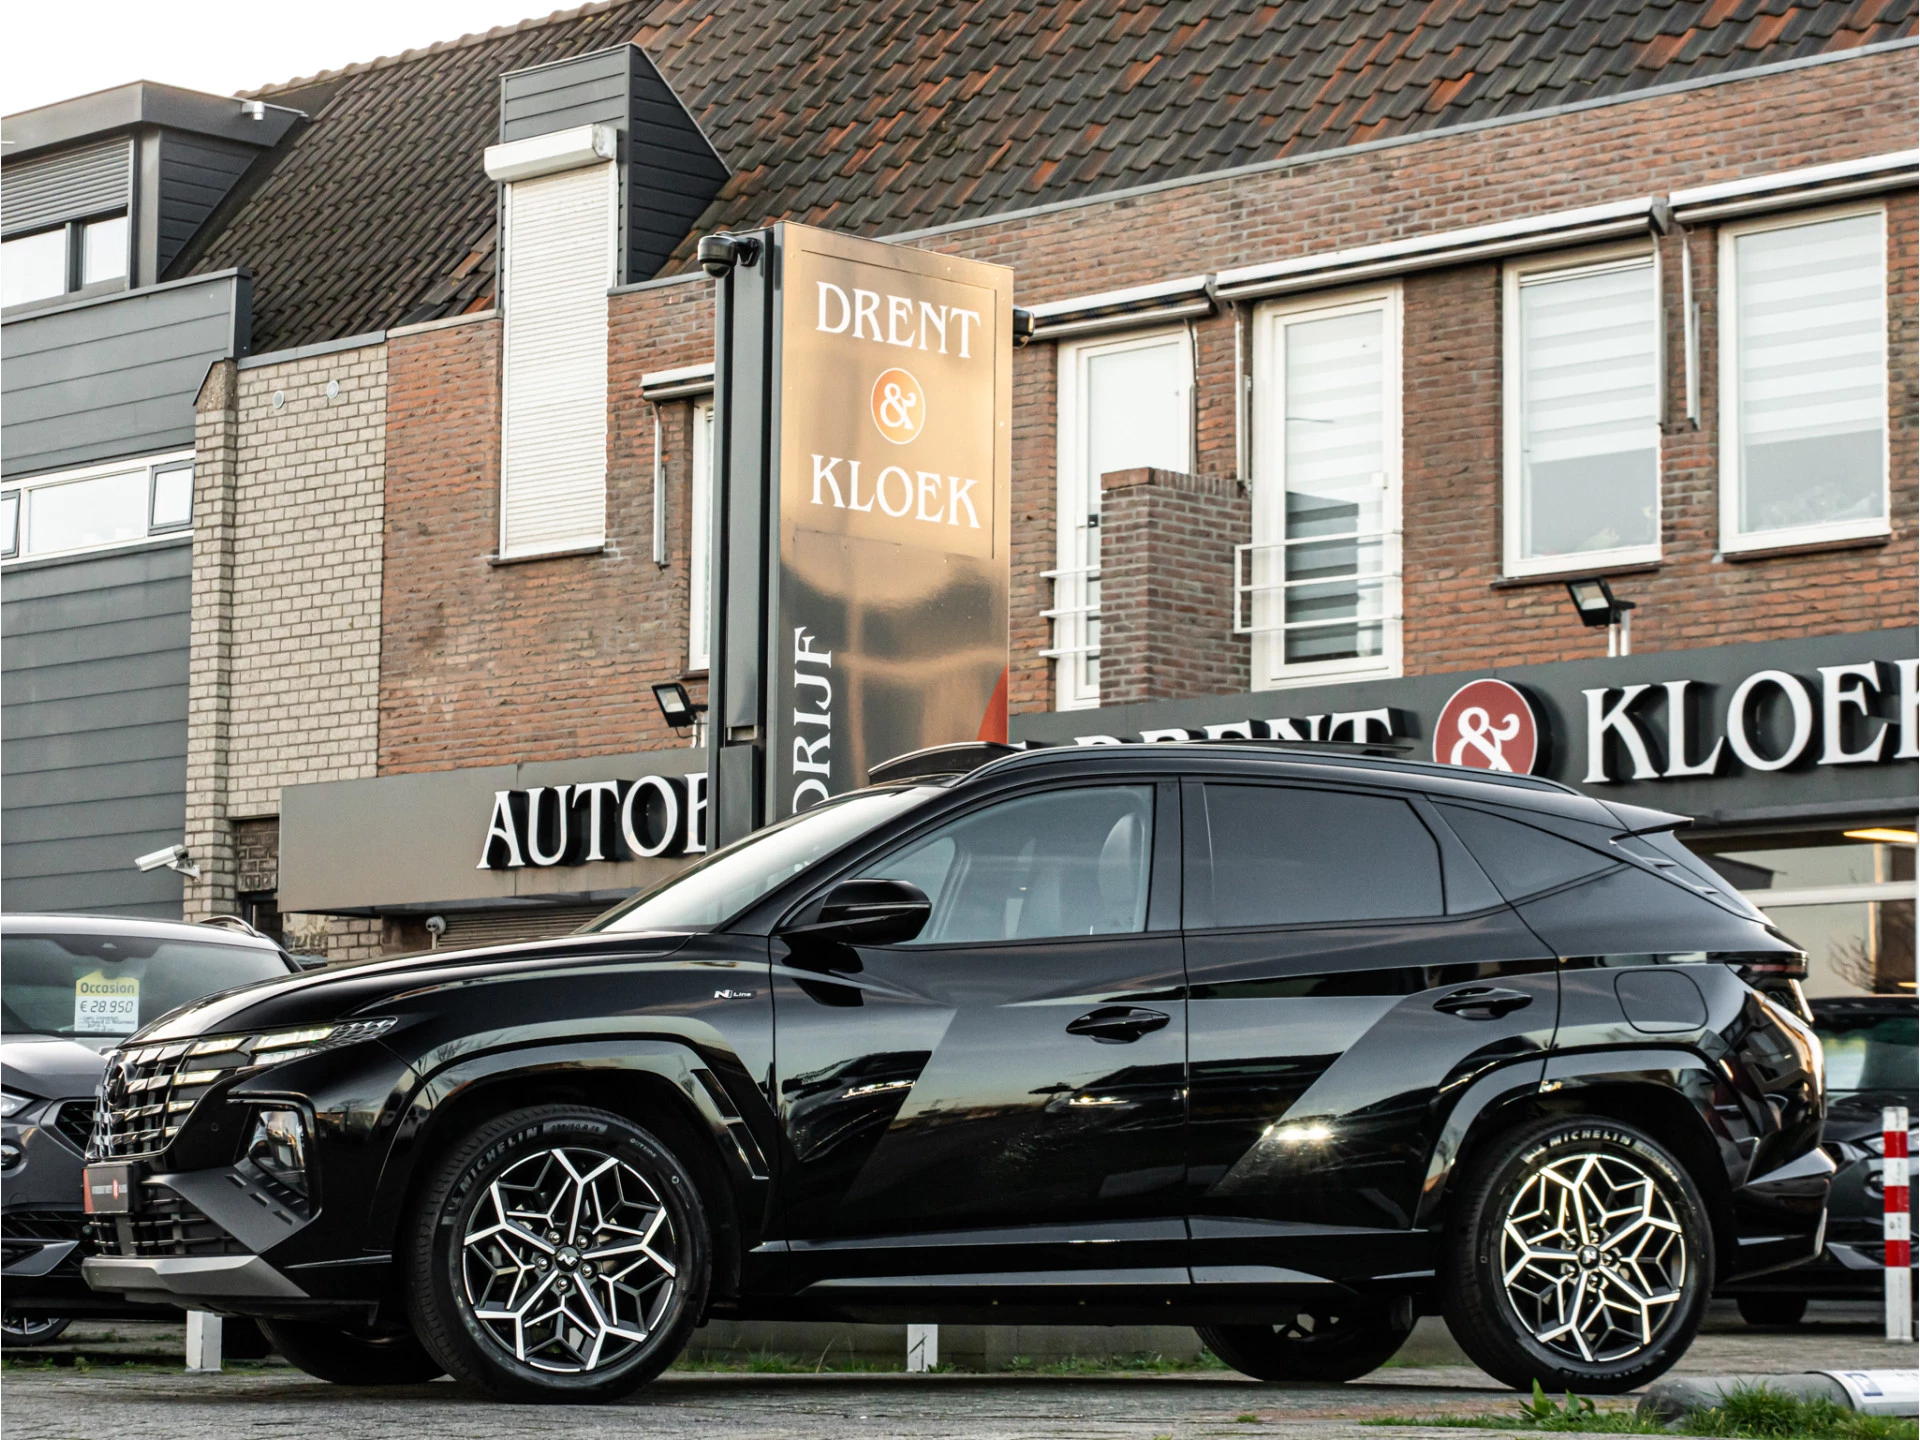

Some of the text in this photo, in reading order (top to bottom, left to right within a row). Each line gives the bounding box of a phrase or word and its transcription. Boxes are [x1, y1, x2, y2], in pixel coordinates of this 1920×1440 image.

[815, 281, 982, 359] DRENT
[879, 382, 918, 431] &
[809, 453, 982, 529] KLOEK
[80, 982, 135, 994] Occasion
[80, 1000, 134, 1014] € 28.950
[459, 1126, 538, 1193] MICHELIN
[1549, 1129, 1632, 1148] MICHELIN
